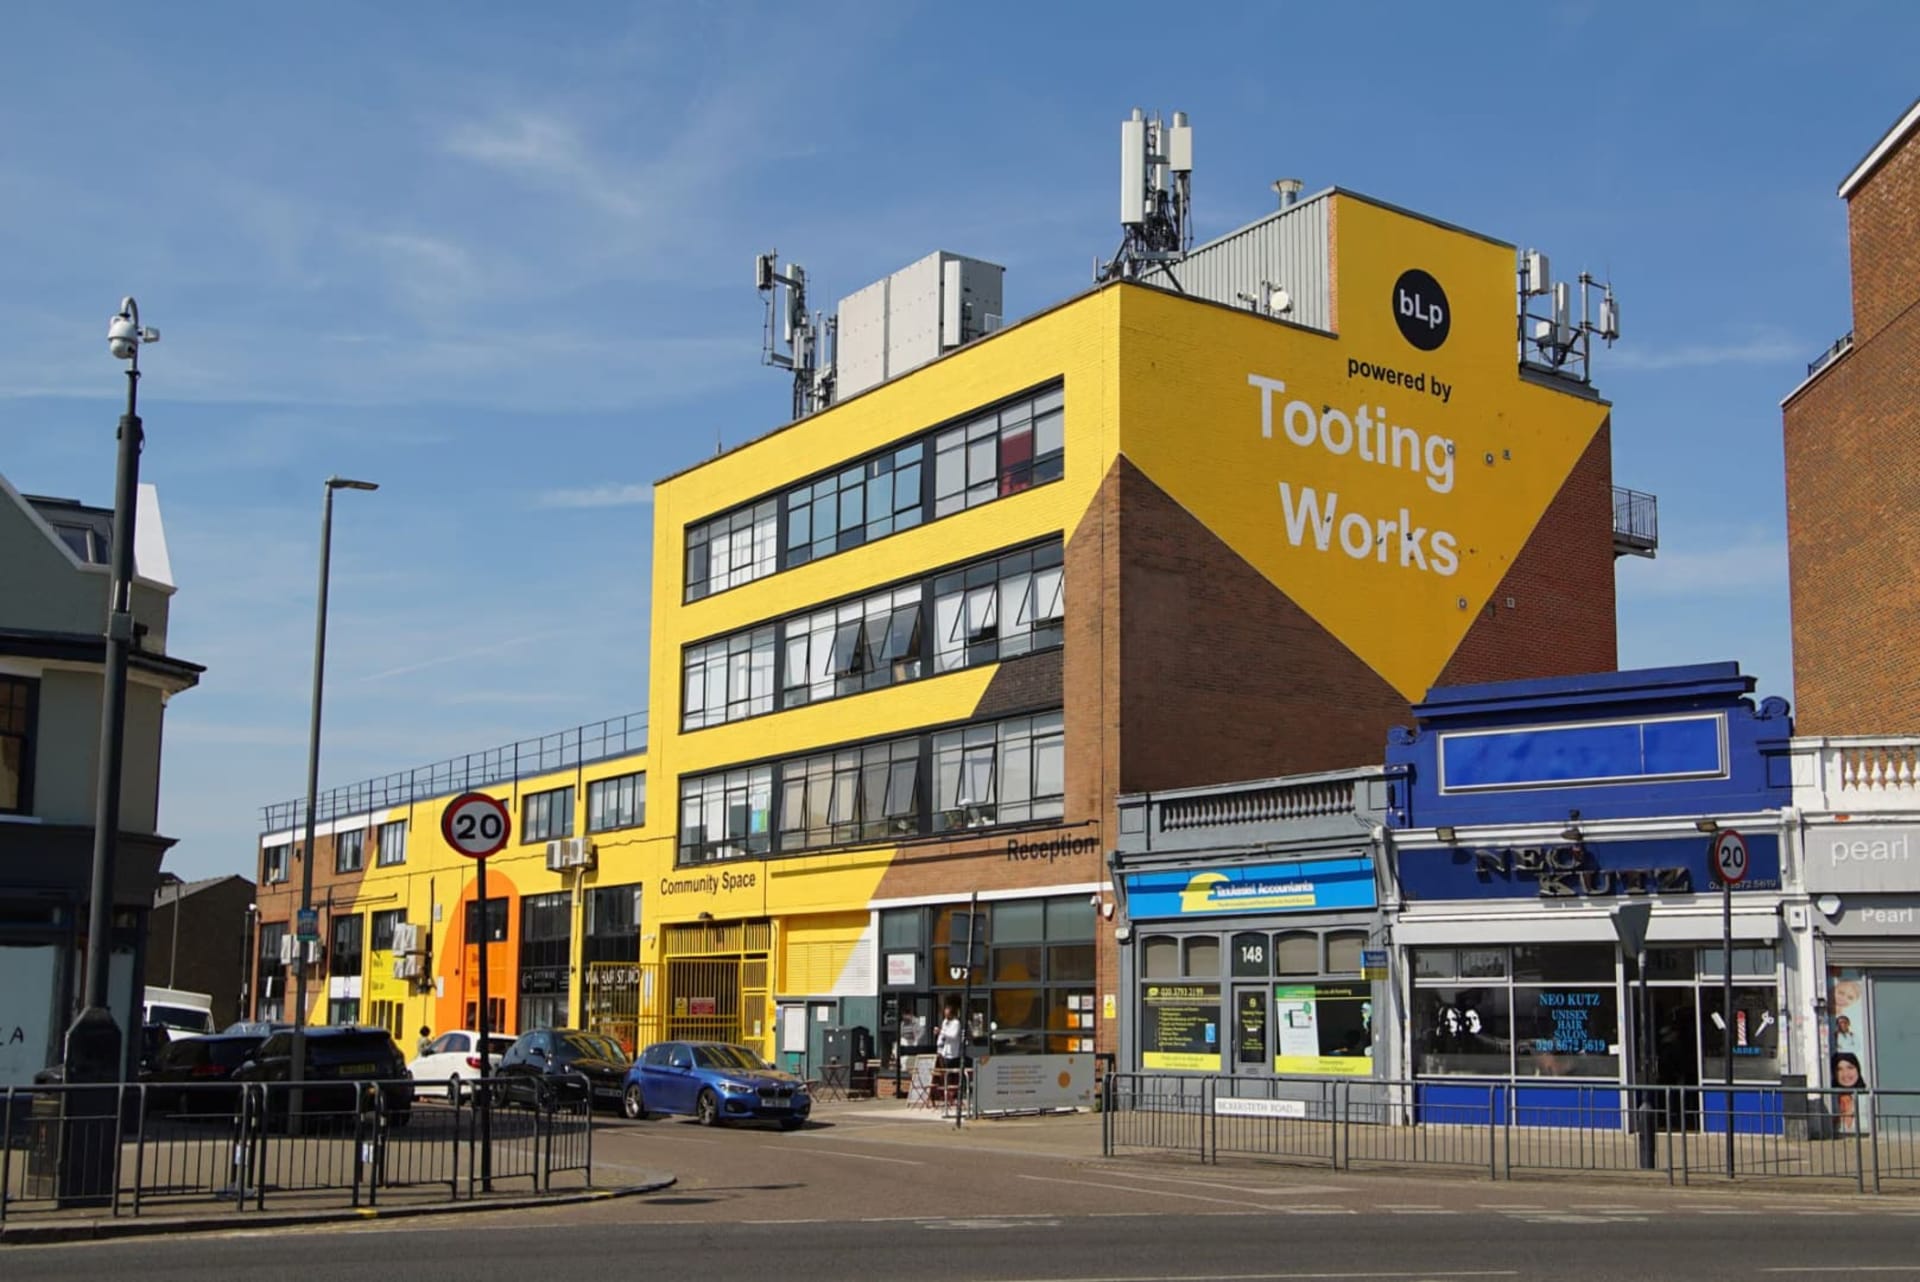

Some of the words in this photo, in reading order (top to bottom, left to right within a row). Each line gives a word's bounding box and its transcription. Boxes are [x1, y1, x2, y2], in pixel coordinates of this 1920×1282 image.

[1399, 289, 1444, 329] bLp
[1347, 357, 1426, 392] powered
[1430, 374, 1452, 403] by
[1247, 373, 1456, 494] Tooting
[1278, 481, 1459, 577] Works
[456, 813, 501, 840] 20
[1007, 833, 1095, 864] Reception
[1475, 846, 1583, 872] NEO
[1721, 846, 1744, 868] 20
[1832, 833, 1908, 867] pearl
[660, 874, 719, 896] Community
[722, 871, 756, 893] Space
[1258, 880, 1314, 895] Accountants
[1538, 867, 1690, 896] KUTZ
[1862, 907, 1913, 922] Pearl
[1242, 946, 1263, 963] 148
[1539, 993, 1565, 1006] NEO
[1568, 992, 1600, 1006] KUTZ
[1552, 1009, 1588, 1020] UNISEX
[1557, 1020, 1582, 1030] HAIR
[1535, 1039, 1554, 1051] 020
[1553, 1030, 1588, 1040] SALON
